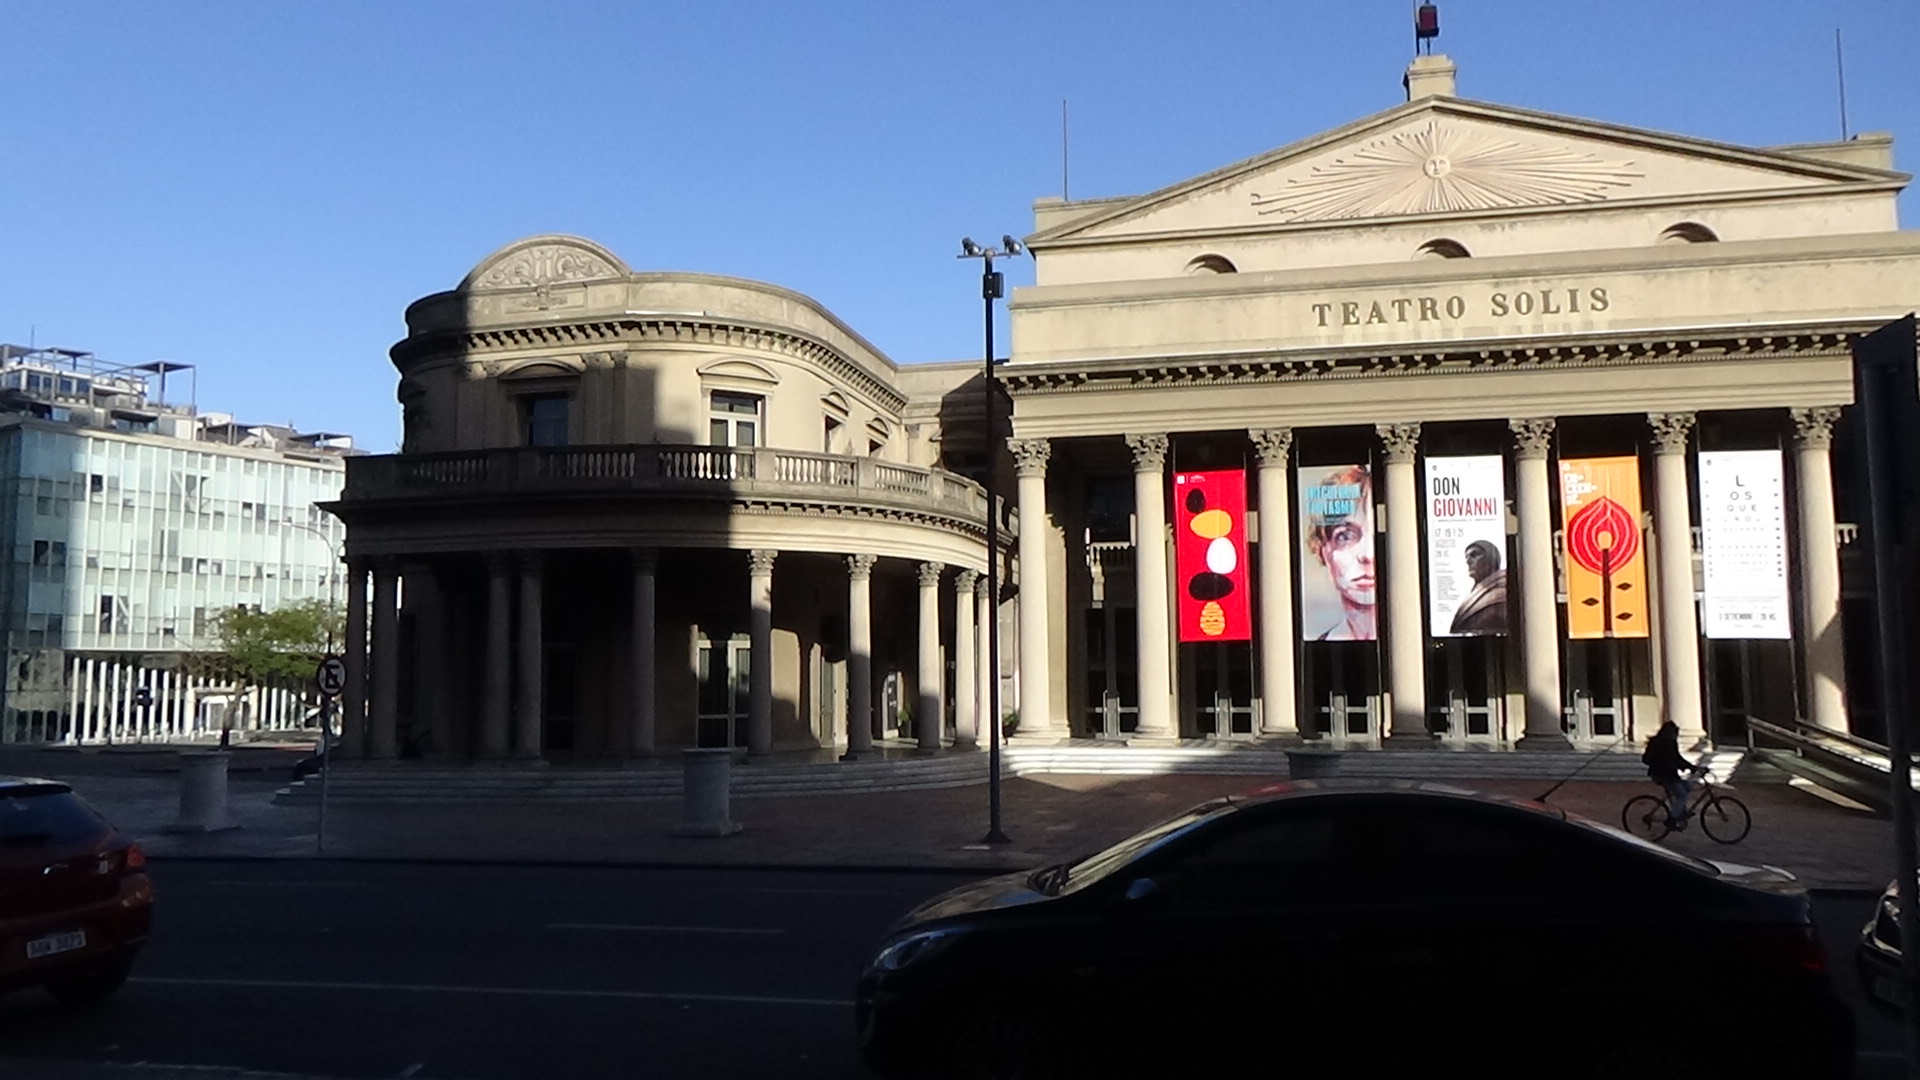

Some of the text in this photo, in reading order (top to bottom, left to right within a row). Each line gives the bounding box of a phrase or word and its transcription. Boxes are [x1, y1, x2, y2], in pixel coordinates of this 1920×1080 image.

[1311, 287, 1610, 327] TEATRO SOLIS
[1433, 477, 1460, 496] DON
[1735, 475, 1745, 487] L
[1433, 497, 1497, 517] GIOVANNI
